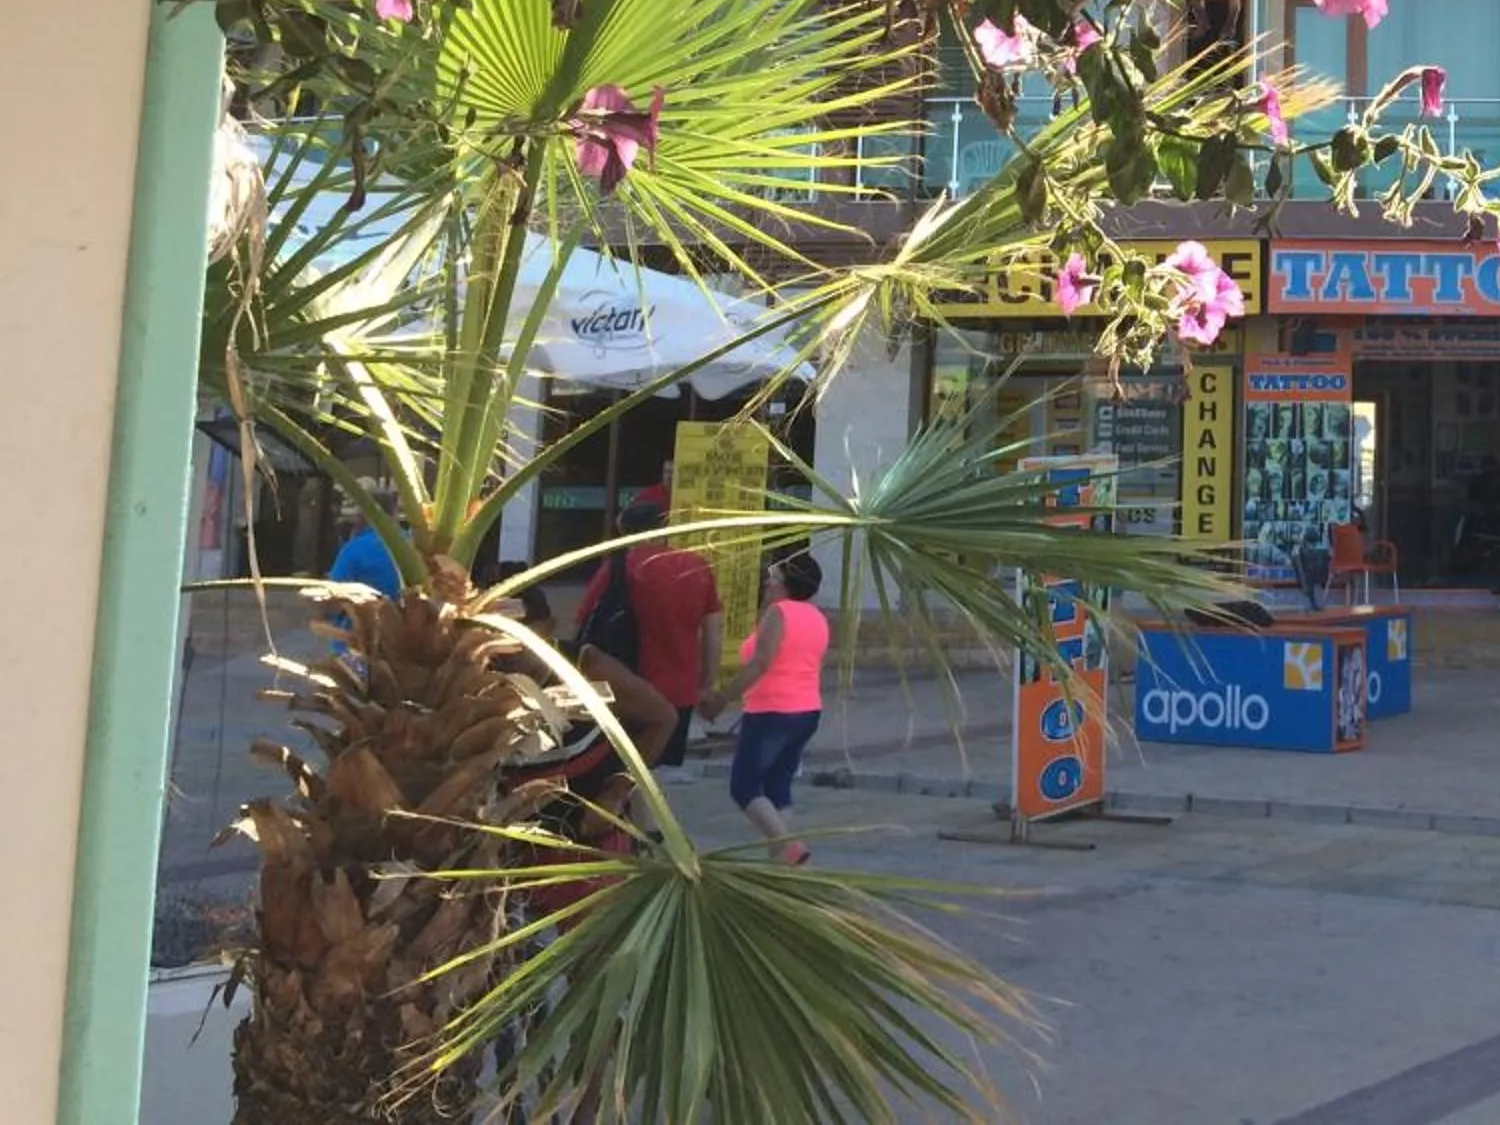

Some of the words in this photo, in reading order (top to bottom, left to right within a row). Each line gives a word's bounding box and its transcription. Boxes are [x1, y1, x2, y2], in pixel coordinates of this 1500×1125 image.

[571, 302, 656, 336] victory
[1248, 373, 1347, 391] TATTOO
[1196, 372, 1217, 534] CHANGE
[1142, 684, 1270, 734] apollo
